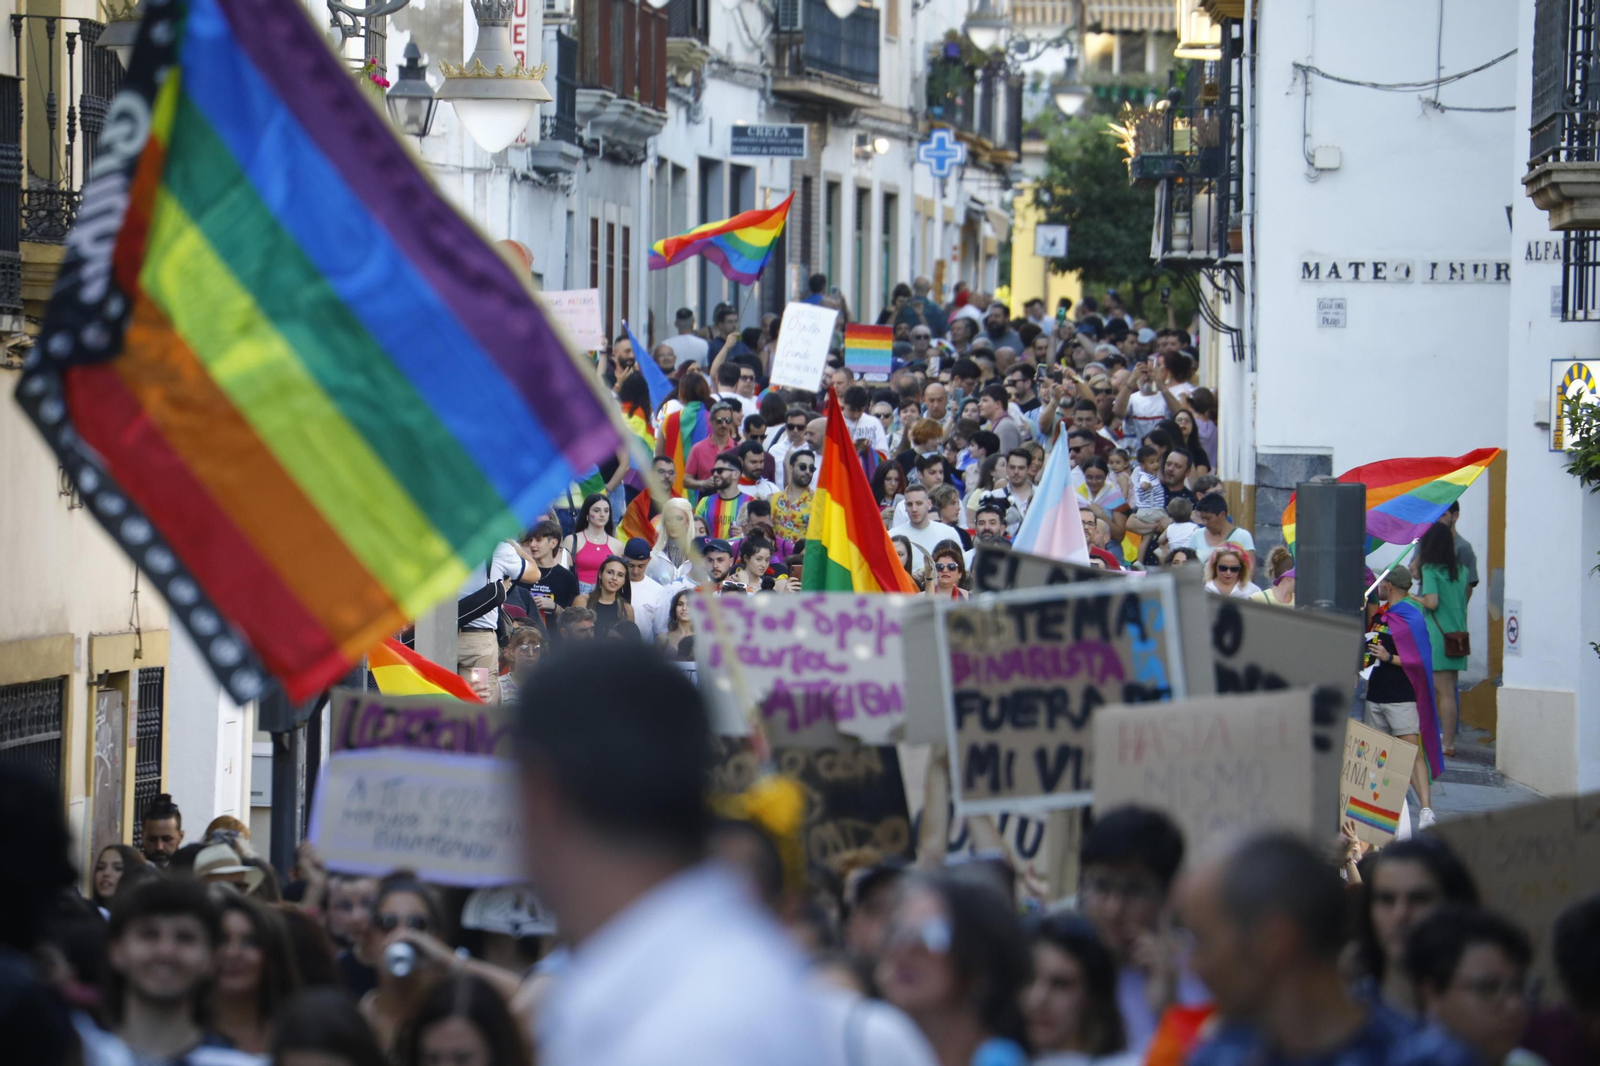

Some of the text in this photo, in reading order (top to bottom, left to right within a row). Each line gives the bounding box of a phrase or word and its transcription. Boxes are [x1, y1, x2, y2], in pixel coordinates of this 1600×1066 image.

[747, 126, 790, 137] CRETA
[1301, 261, 1410, 281] MATEO
[953, 639, 1125, 685] BINARISTA
[1345, 735, 1370, 761] AMOR
[965, 742, 1091, 793] MI VI
